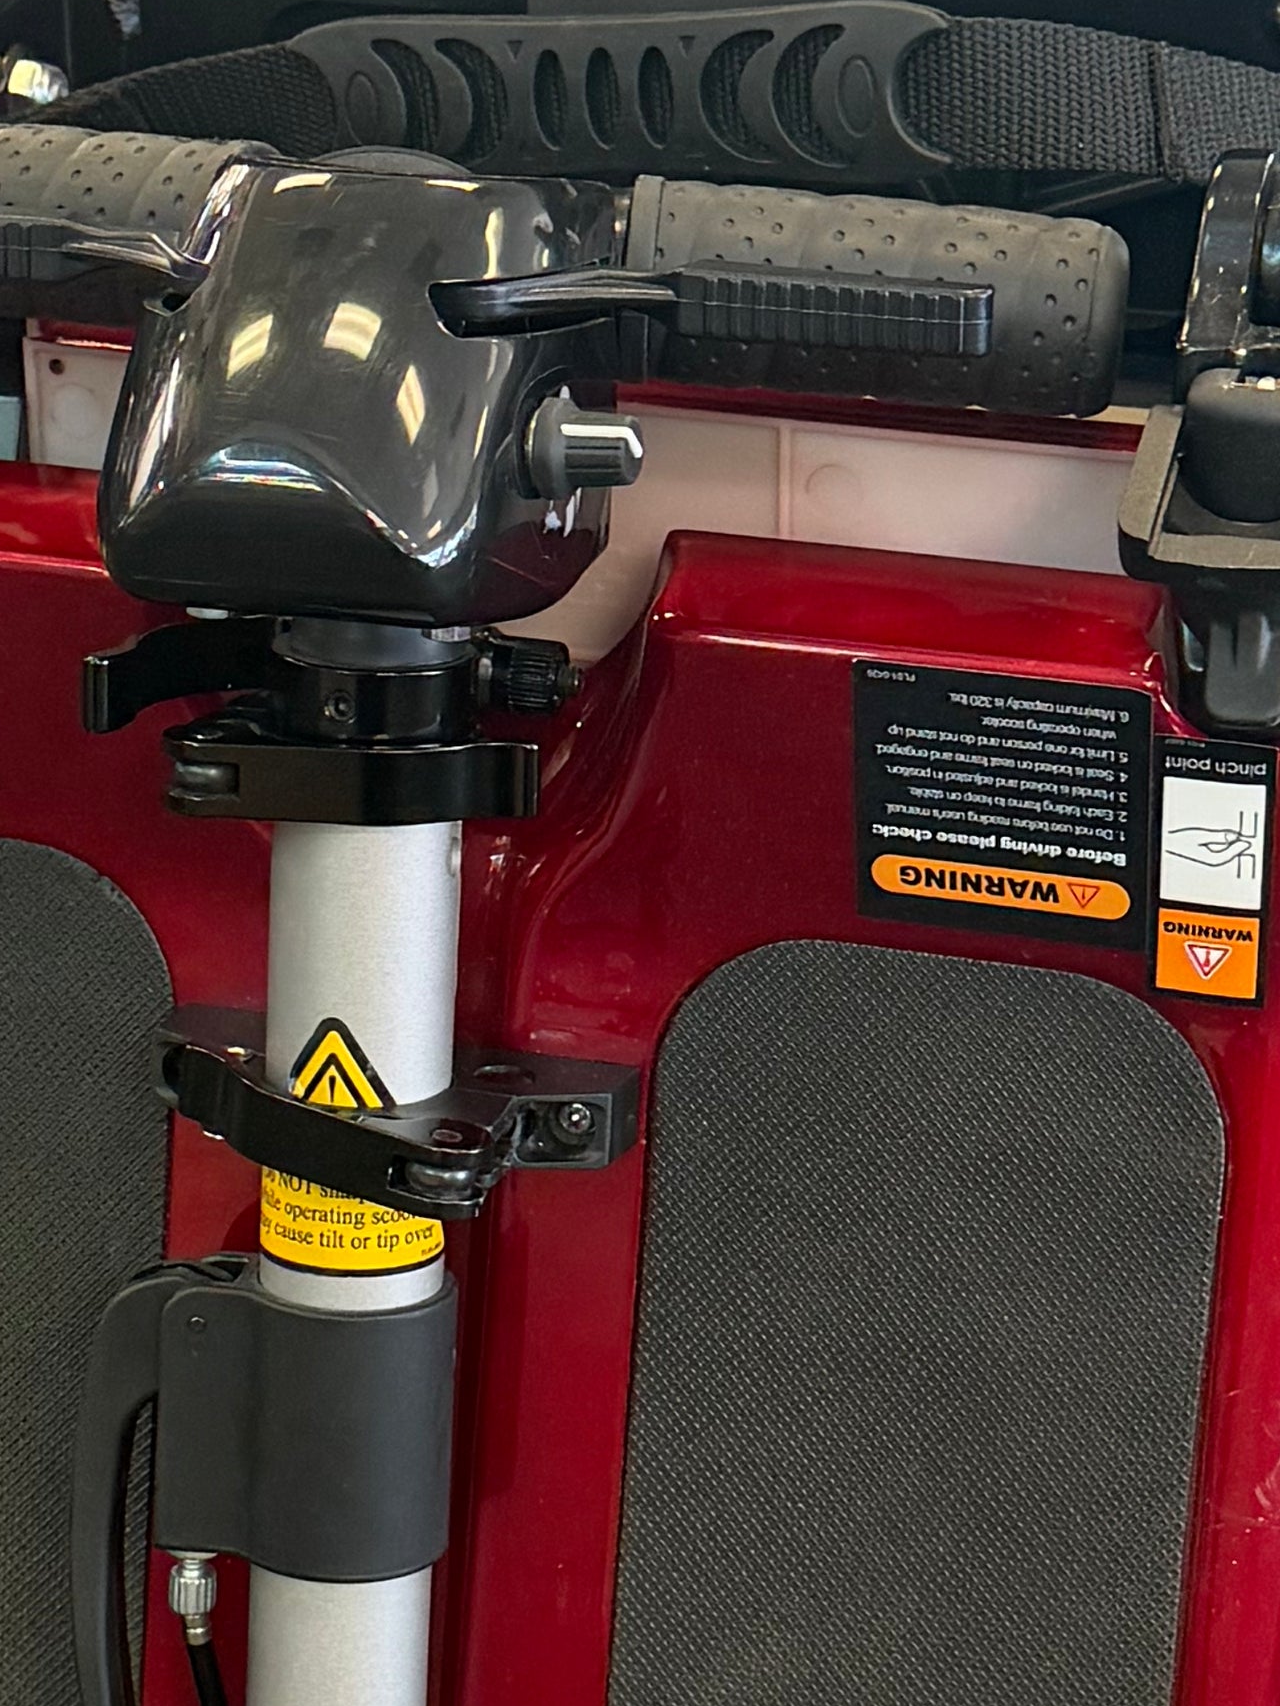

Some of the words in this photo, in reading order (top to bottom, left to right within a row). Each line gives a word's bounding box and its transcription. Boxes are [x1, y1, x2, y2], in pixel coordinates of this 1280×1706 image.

[969, 695, 993, 709] 320
[993, 697, 1005, 710] is
[1005, 696, 1055, 713] capacity
[1055, 703, 1116, 723] Maximum
[887, 723, 904, 736] up
[905, 727, 938, 740] stand
[1026, 718, 1082, 736] operating
[1082, 727, 1117, 741] when
[938, 730, 959, 742] not
[959, 733, 976, 746] do
[977, 735, 1001, 747] and
[1001, 738, 1044, 752] person
[1044, 743, 1068, 755] one
[929, 750, 954, 762] and
[1069, 746, 1086, 759] for
[1086, 747, 1115, 762] Limit
[954, 752, 989, 768] frame
[989, 756, 1016, 768] seat
[1016, 760, 1034, 770] on
[1164, 755, 1211, 771] point
[932, 770, 944, 780] in
[1033, 761, 1074, 777] locked
[1074, 766, 1085, 778] is
[1086, 767, 1115, 782] Seat
[1215, 761, 1267, 778] pinch
[944, 771, 995, 786] adjusted
[995, 777, 1019, 788] and
[1019, 779, 1059, 795] locked
[1059, 784, 1070, 794] is
[945, 791, 962, 801] on
[963, 791, 993, 807] keep
[993, 796, 1006, 808] to
[1116, 791, 1128, 803] 3.
[1007, 797, 1042, 813] frame
[1042, 799, 1081, 818] folding
[967, 810, 1011, 826] reading
[1082, 807, 1114, 822] Each
[1012, 817, 1050, 833] before
[1049, 822, 1074, 833] use
[1074, 825, 1094, 836] not
[872, 823, 933, 842] check:
[1094, 828, 1114, 841] Do
[1115, 830, 1126, 842] 1.
[935, 831, 996, 850] please
[1000, 836, 1062, 858] driving
[1065, 846, 1127, 867] Before
[899, 865, 1060, 904] WARNING
[1163, 921, 1254, 942] WARNING
[284, 1203, 365, 1230] operating
[275, 1223, 314, 1245] cause
[319, 1229, 345, 1249] tilt
[351, 1236, 372, 1250] or
[376, 1229, 400, 1252] tip
[404, 1223, 436, 1245] over
